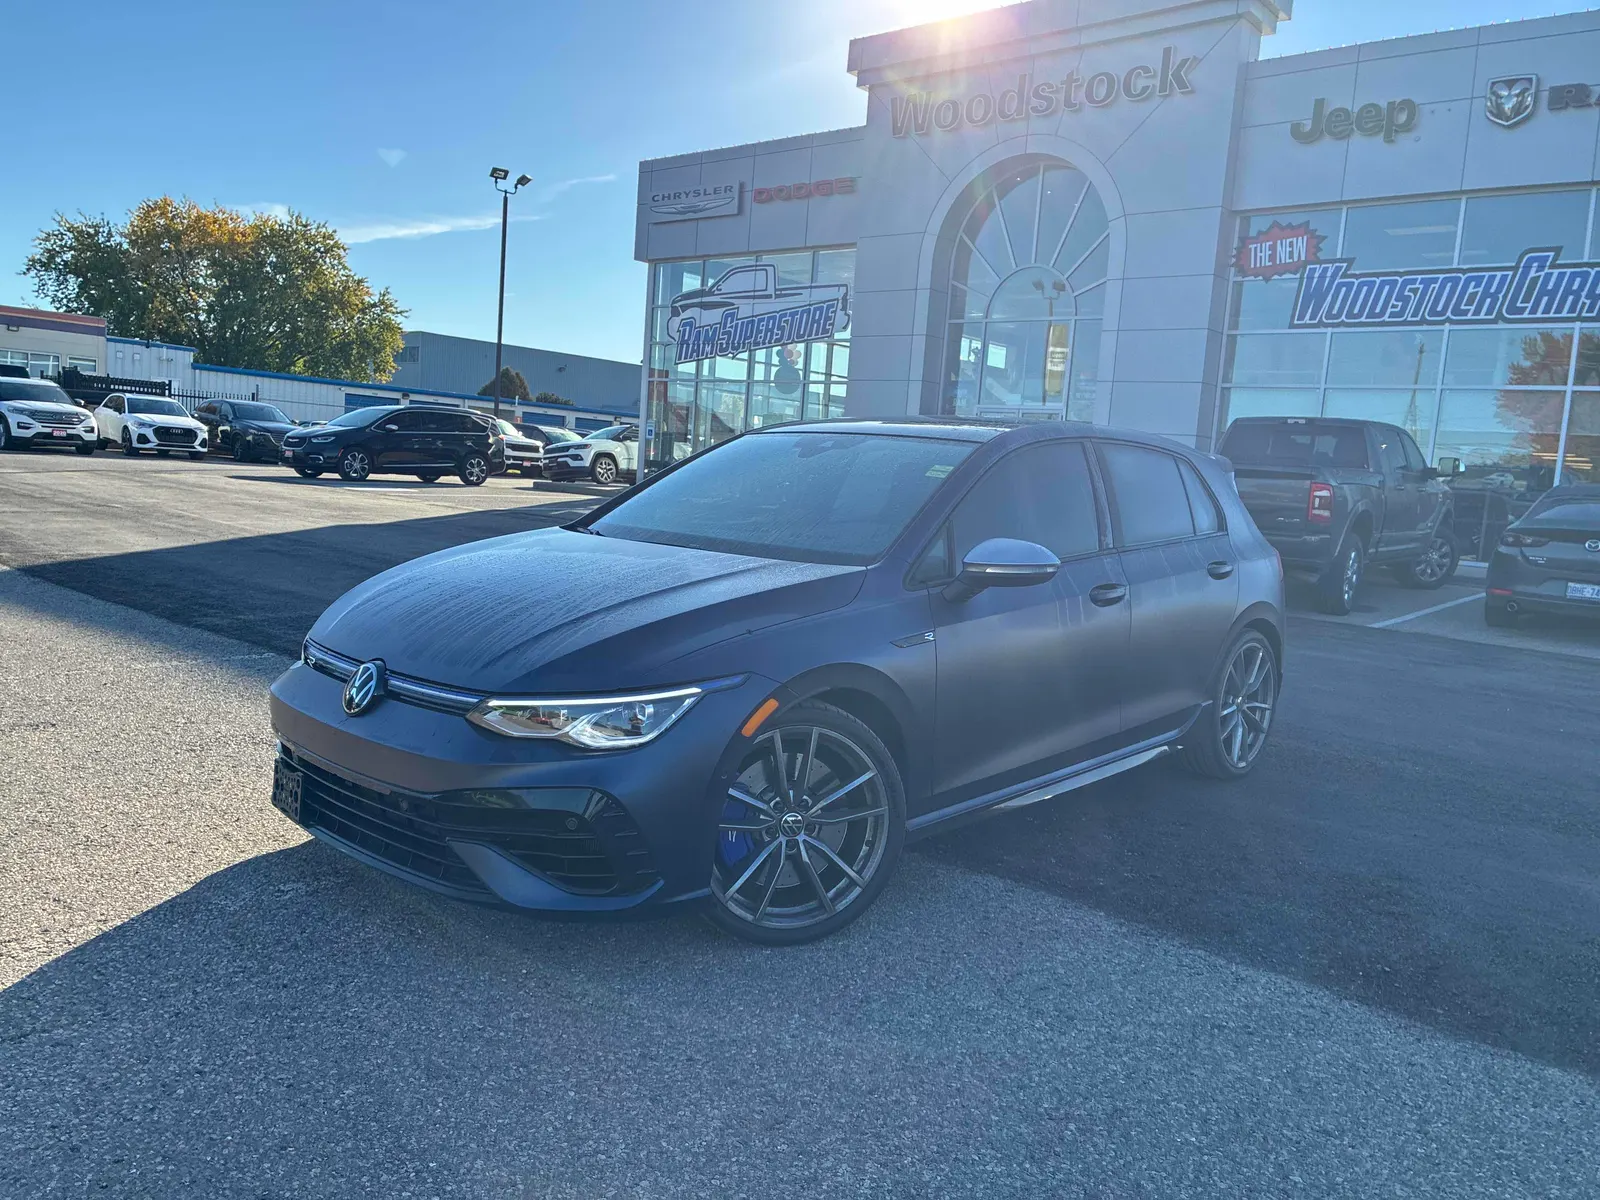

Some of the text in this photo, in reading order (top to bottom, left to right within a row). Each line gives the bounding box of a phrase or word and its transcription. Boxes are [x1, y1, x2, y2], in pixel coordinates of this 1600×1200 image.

[889, 45, 1195, 139] Woodstock
[1290, 98, 1417, 143] Jeep
[652, 185, 733, 203] CHRYSLER
[753, 177, 857, 203] DODGE
[1248, 235, 1307, 269] THE NEW
[1294, 263, 1512, 323] WOODSTOCK
[677, 303, 835, 362] RAM SUPERSTORE
